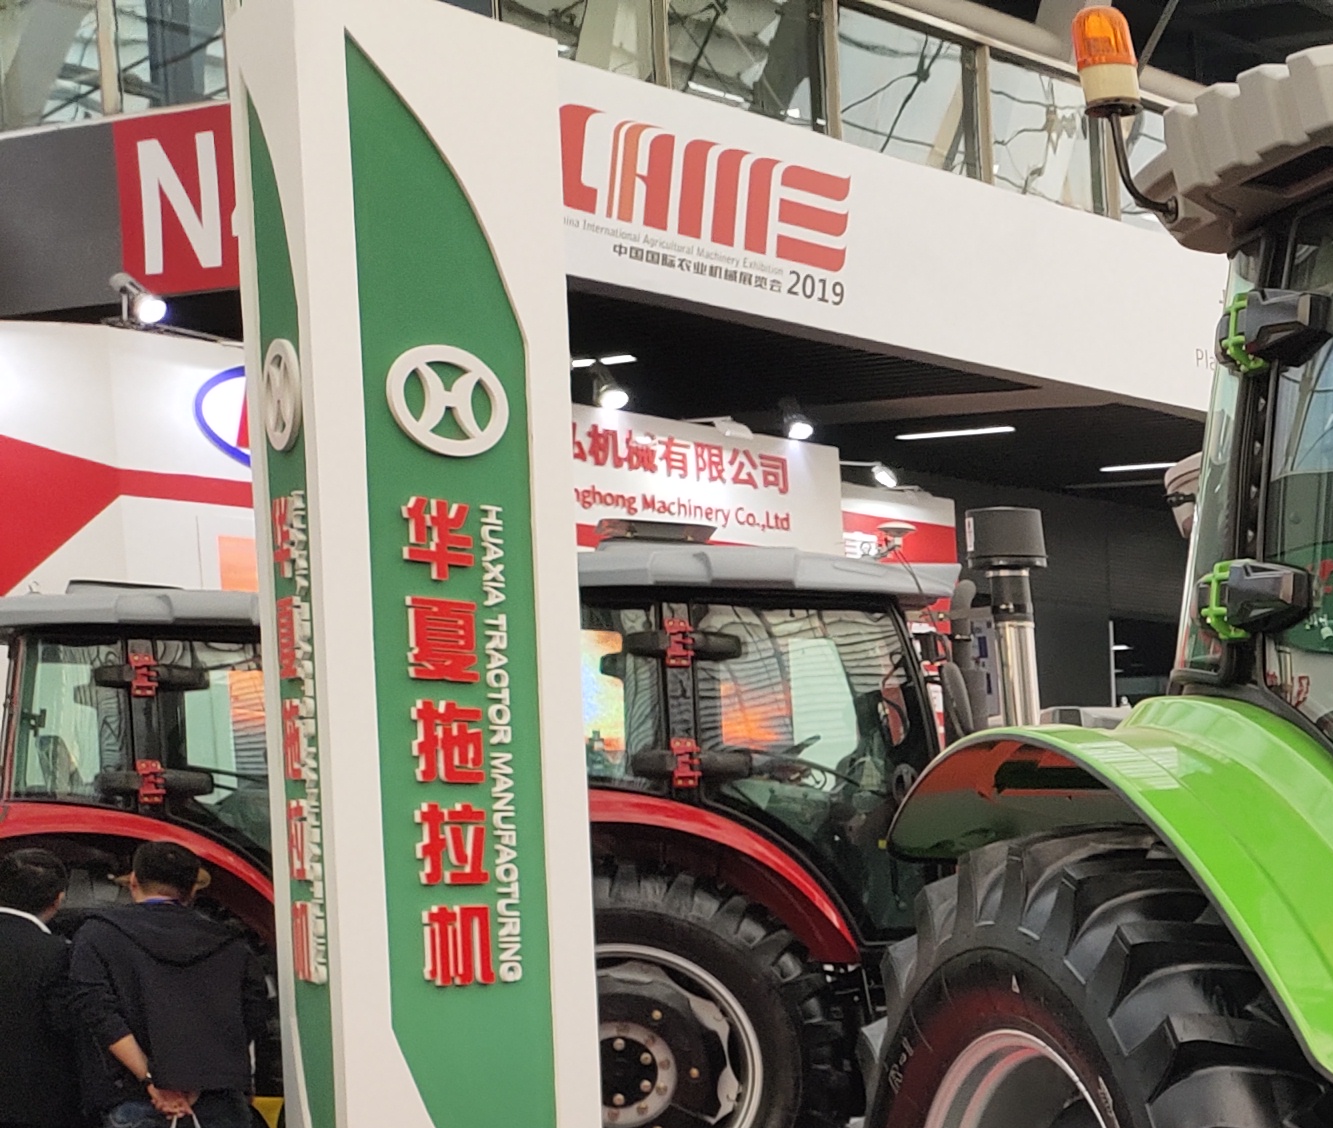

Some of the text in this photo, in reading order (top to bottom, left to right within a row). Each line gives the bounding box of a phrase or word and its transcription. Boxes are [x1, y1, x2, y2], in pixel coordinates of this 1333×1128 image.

[137, 131, 238, 275] N
[583, 219, 640, 243] International
[643, 235, 693, 255] Agricultural
[697, 246, 740, 267] Machinery
[742, 257, 783, 276] Exhibition
[613, 243, 783, 293] 中国国际农业机械展览会
[786, 270, 845, 306] 2019
[642, 494, 731, 525] Machinery
[735, 506, 790, 532] Co.,Ltd
[479, 504, 507, 608] HUAXIA
[482, 612, 513, 746] TRACTOR
[401, 495, 496, 988] 华夏拖拉机
